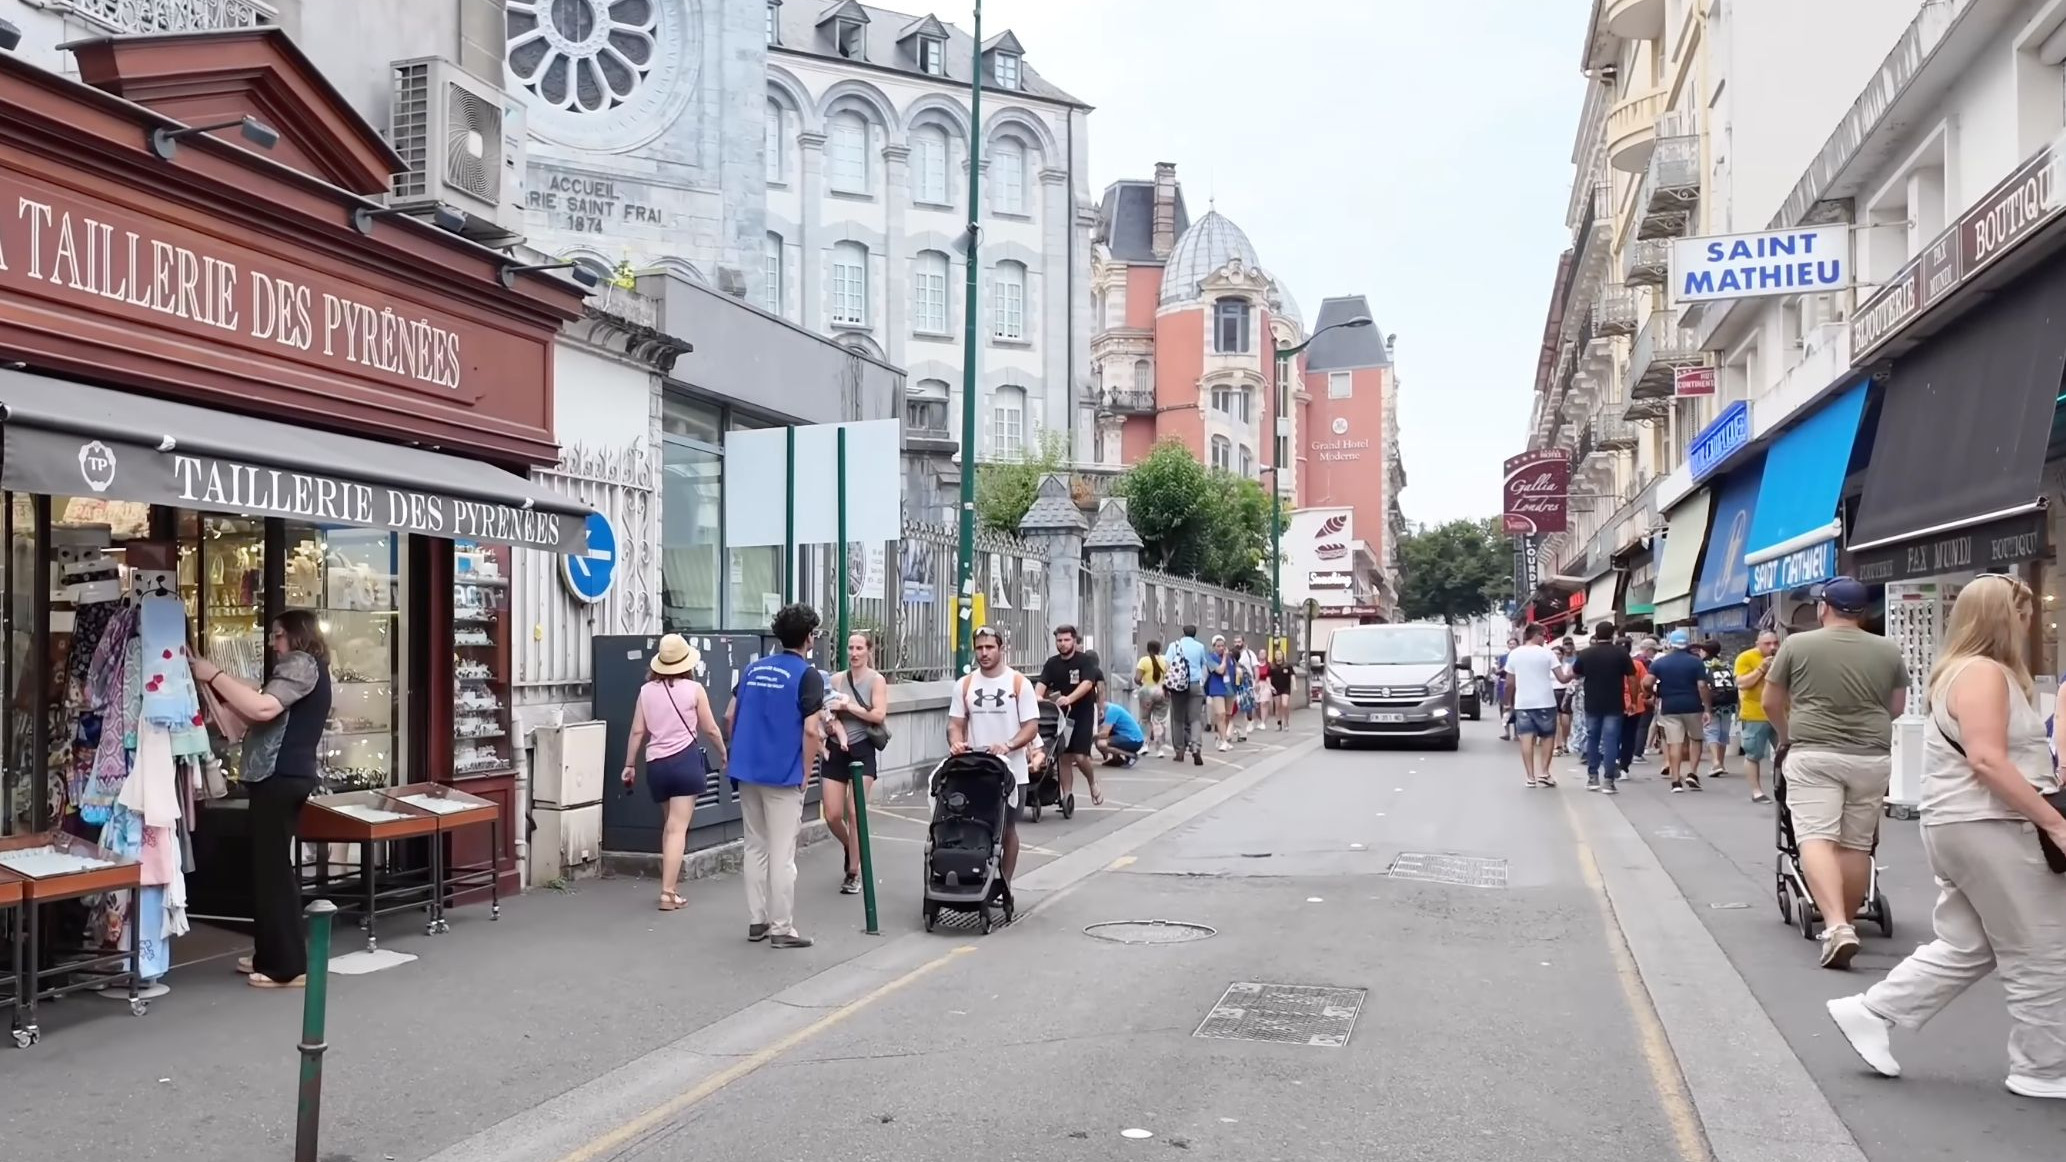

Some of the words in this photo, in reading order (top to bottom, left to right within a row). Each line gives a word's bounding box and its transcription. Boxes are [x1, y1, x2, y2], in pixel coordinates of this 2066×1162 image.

[551, 176, 620, 200] ACCUEIL
[525, 190, 557, 210] RIE
[567, 197, 615, 217] SAINT
[624, 204, 662, 224] FRAI
[1975, 158, 2060, 261] BOUTIQU
[567, 214, 603, 234] 1874
[1706, 233, 1818, 263] SAINT
[1933, 240, 1947, 266] PAX
[1684, 259, 1840, 295] MATHIEU
[1929, 264, 1953, 299] MUNDI
[19, 196, 239, 331] TAILLERIE
[251, 271, 312, 350] DES
[323, 293, 460, 389] PYRÉNÉES
[1855, 276, 1915, 353] BIJOUTERIE
[1311, 440, 1341, 450] Grand
[1343, 438, 1369, 449] Hotel
[1319, 451, 1361, 461] Moderne
[88, 456, 108, 471] TP
[175, 455, 373, 524] TAILLERIE
[387, 489, 444, 531] DES
[1509, 472, 1558, 496] Gallia
[1510, 497, 1560, 513] Londres
[1907, 545, 1928, 573] PAX
[1934, 536, 1972, 569] MUNDI
